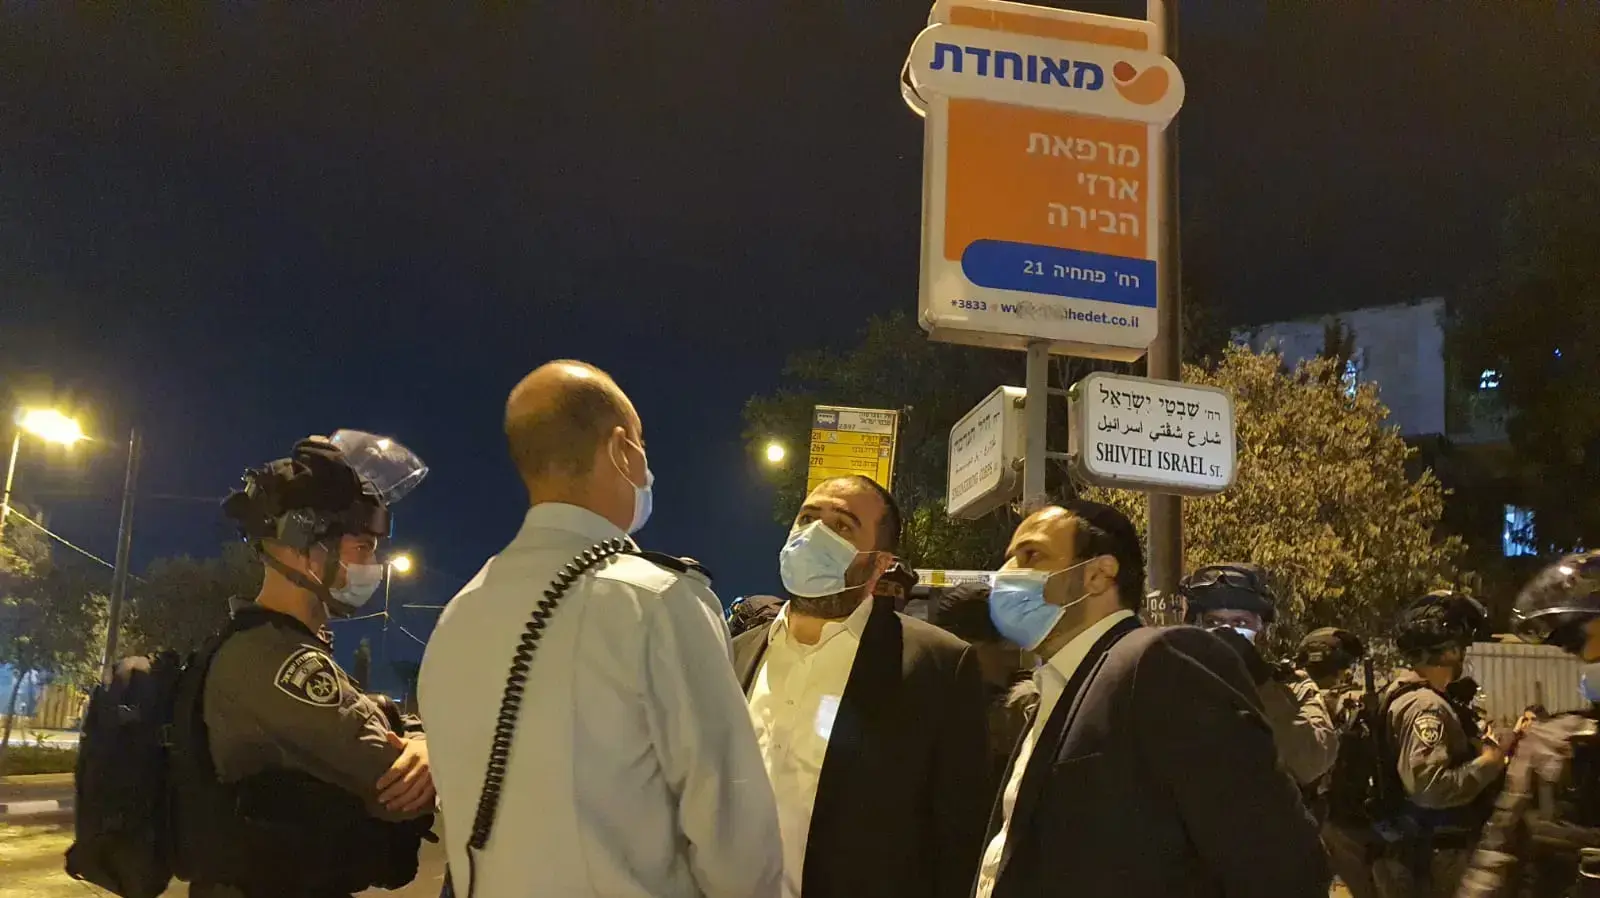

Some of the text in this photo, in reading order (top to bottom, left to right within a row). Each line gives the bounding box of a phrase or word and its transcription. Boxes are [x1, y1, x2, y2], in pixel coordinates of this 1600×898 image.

[930, 42, 1104, 91] מאוחדת
[1026, 132, 1140, 168] מרפאת
[1077, 172, 1139, 202] ארזי
[1048, 202, 1139, 237] הבירה
[1023, 260, 1044, 276] 21
[1053, 264, 1106, 283] פתחיה
[1187, 431, 1222, 448] شارع
[811, 457, 824, 466] 270
[1096, 442, 1223, 478] SHIVTEI ISRAEL ST.
